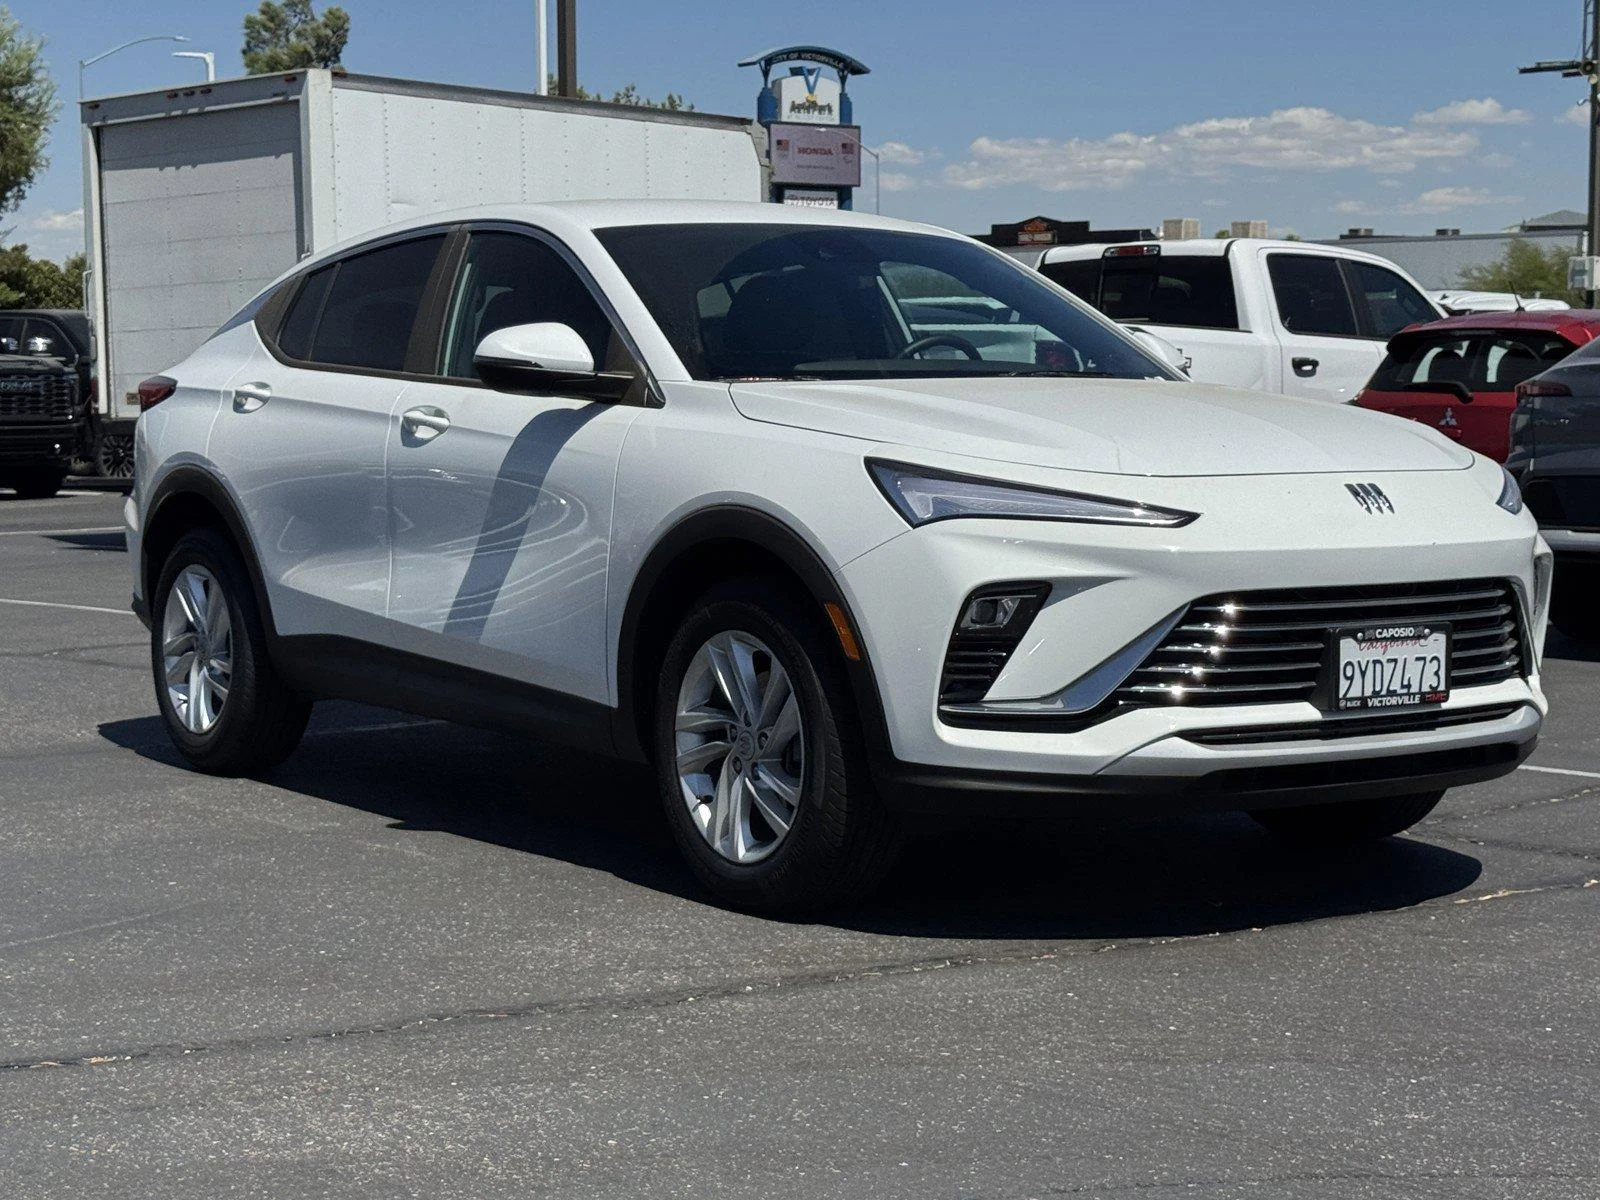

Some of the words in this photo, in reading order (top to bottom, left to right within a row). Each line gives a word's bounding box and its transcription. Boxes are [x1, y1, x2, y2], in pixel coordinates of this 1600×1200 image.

[797, 147, 834, 156] HONDA
[1375, 627, 1415, 639] CAPOSIO
[1343, 656, 1441, 698] 9YDZ473
[1367, 695, 1420, 707] VICTORVILLE
